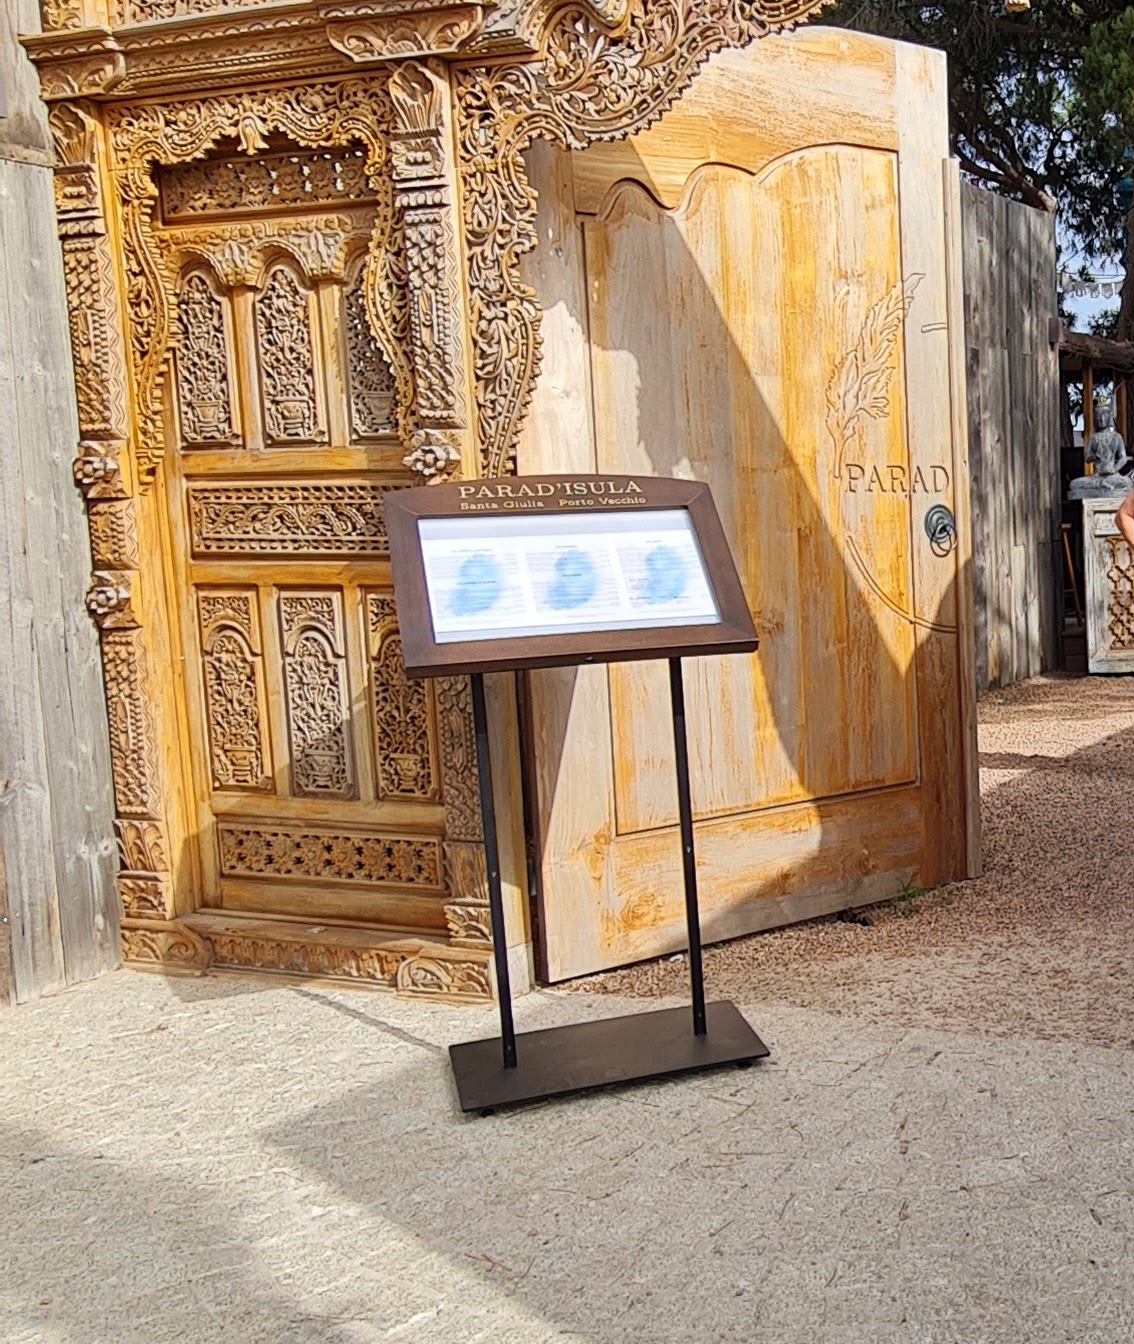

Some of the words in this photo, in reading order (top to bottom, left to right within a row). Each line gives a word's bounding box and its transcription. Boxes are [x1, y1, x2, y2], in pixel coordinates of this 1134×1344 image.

[844, 463, 950, 494] PARAD
[458, 480, 643, 499] PARAD'ISULA
[460, 501, 499, 510] Santa
[503, 499, 545, 509] Giulia
[558, 498, 594, 507] Porto
[598, 496, 647, 506] Vecchio
